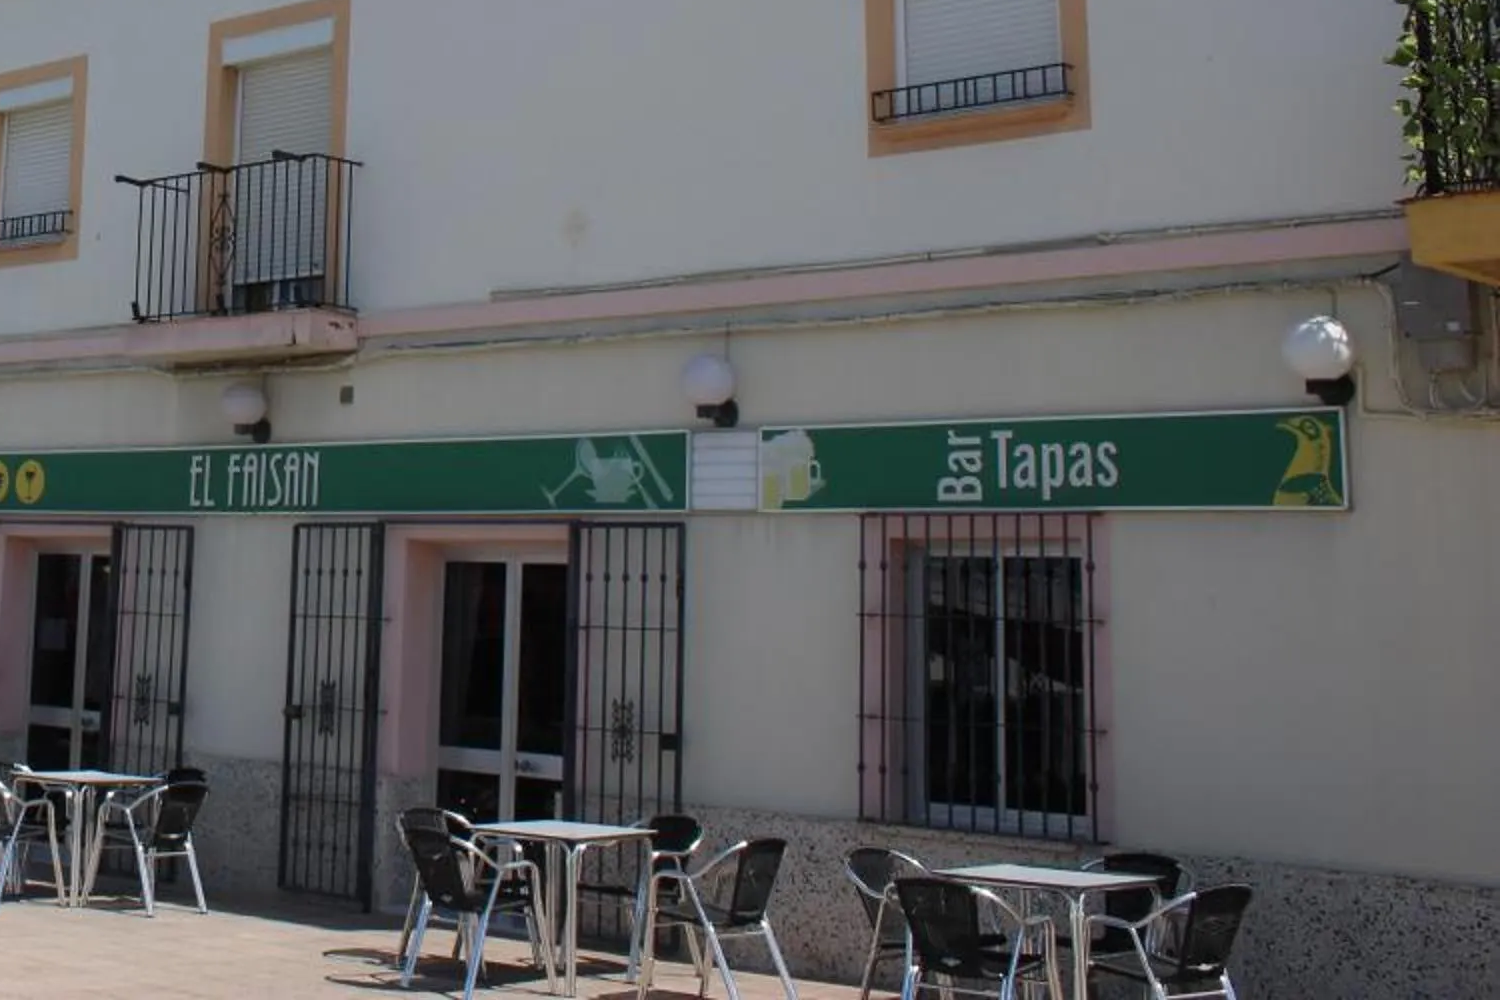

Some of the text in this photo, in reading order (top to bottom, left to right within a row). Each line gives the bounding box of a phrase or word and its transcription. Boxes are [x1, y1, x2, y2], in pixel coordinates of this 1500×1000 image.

[189, 451, 320, 507] EL FAISAN
[937, 430, 983, 502] Bar
[991, 430, 1118, 500] Tapas
